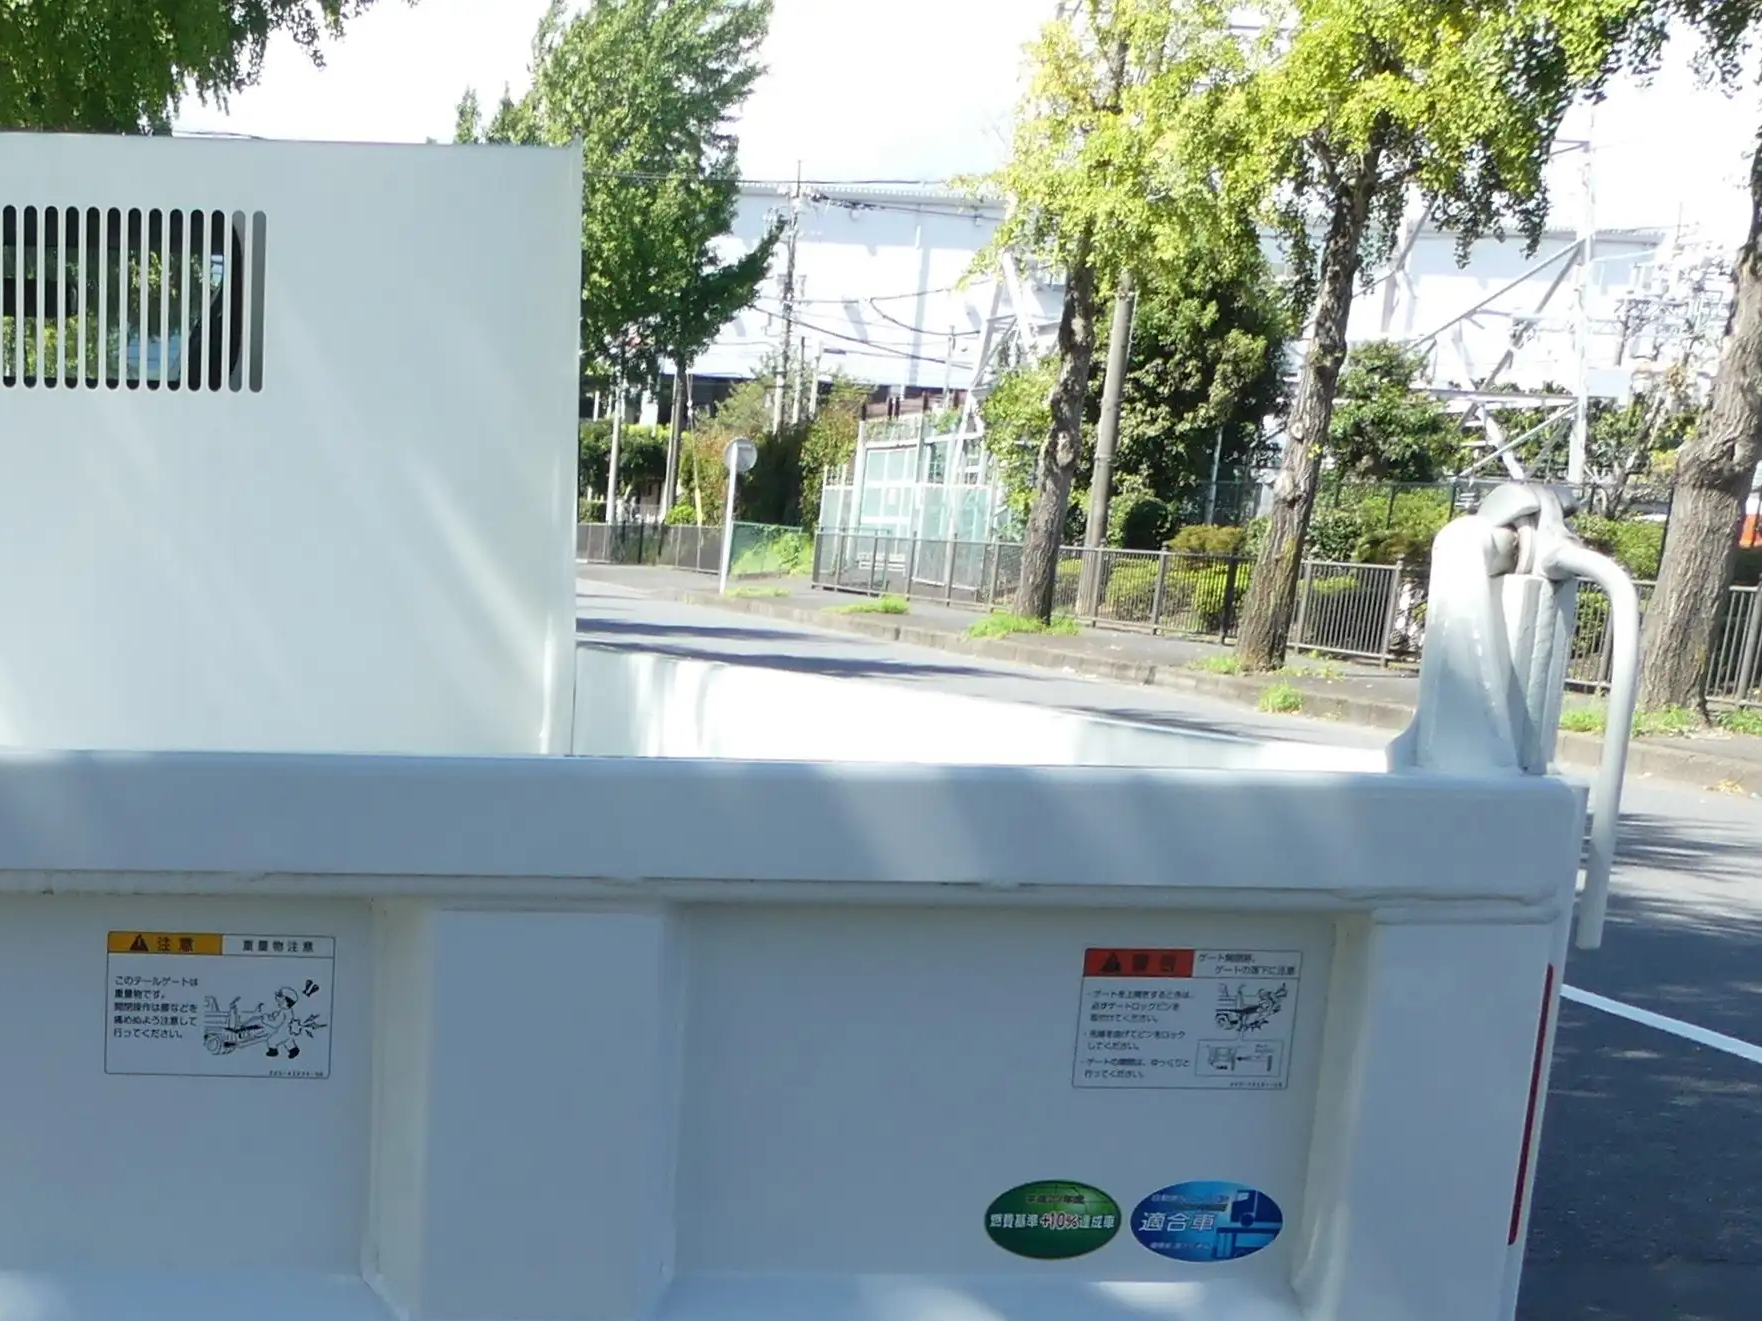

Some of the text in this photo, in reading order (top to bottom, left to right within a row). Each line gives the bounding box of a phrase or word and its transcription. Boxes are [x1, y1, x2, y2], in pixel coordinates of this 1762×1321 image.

[155, 936, 195, 953] 注意
[114, 975, 199, 987] このテールゲートは
[1138, 1211, 1217, 1231] 適合車
